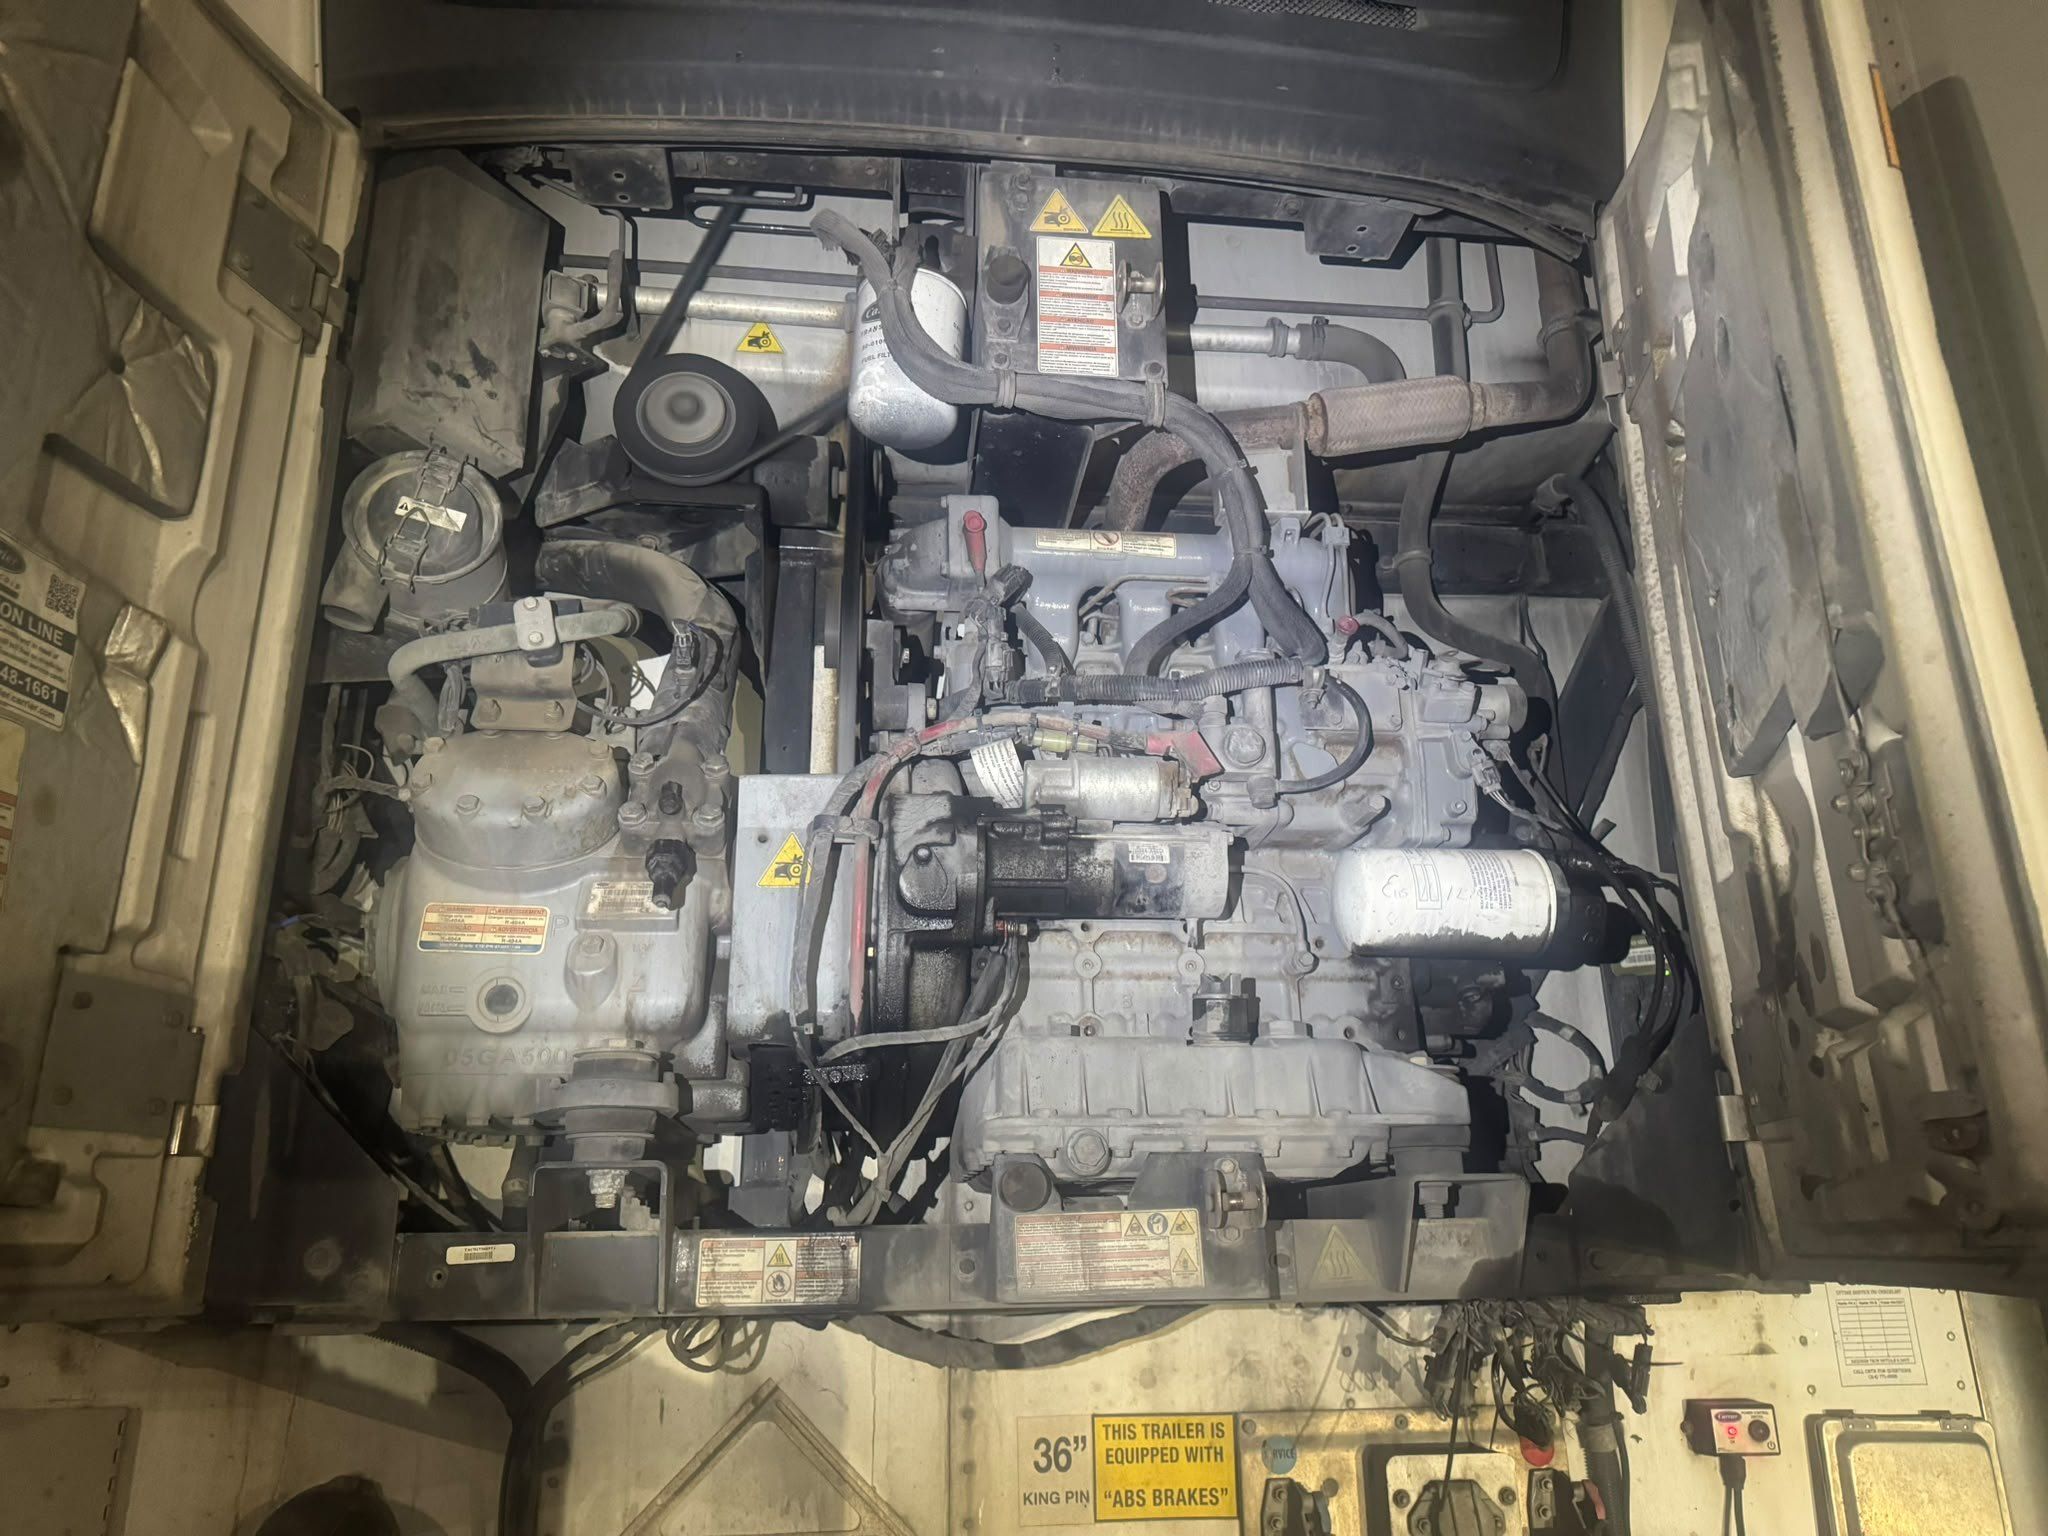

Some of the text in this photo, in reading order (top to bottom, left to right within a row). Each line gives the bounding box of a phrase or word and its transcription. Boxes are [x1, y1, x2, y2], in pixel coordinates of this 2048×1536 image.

[28, 618, 64, 646] LINE
[1102, 1421, 1226, 1441] THIS TRAILER IS
[1105, 1445, 1225, 1467] EQUIPPED WITH
[1023, 1489, 1091, 1506] KING PIN
